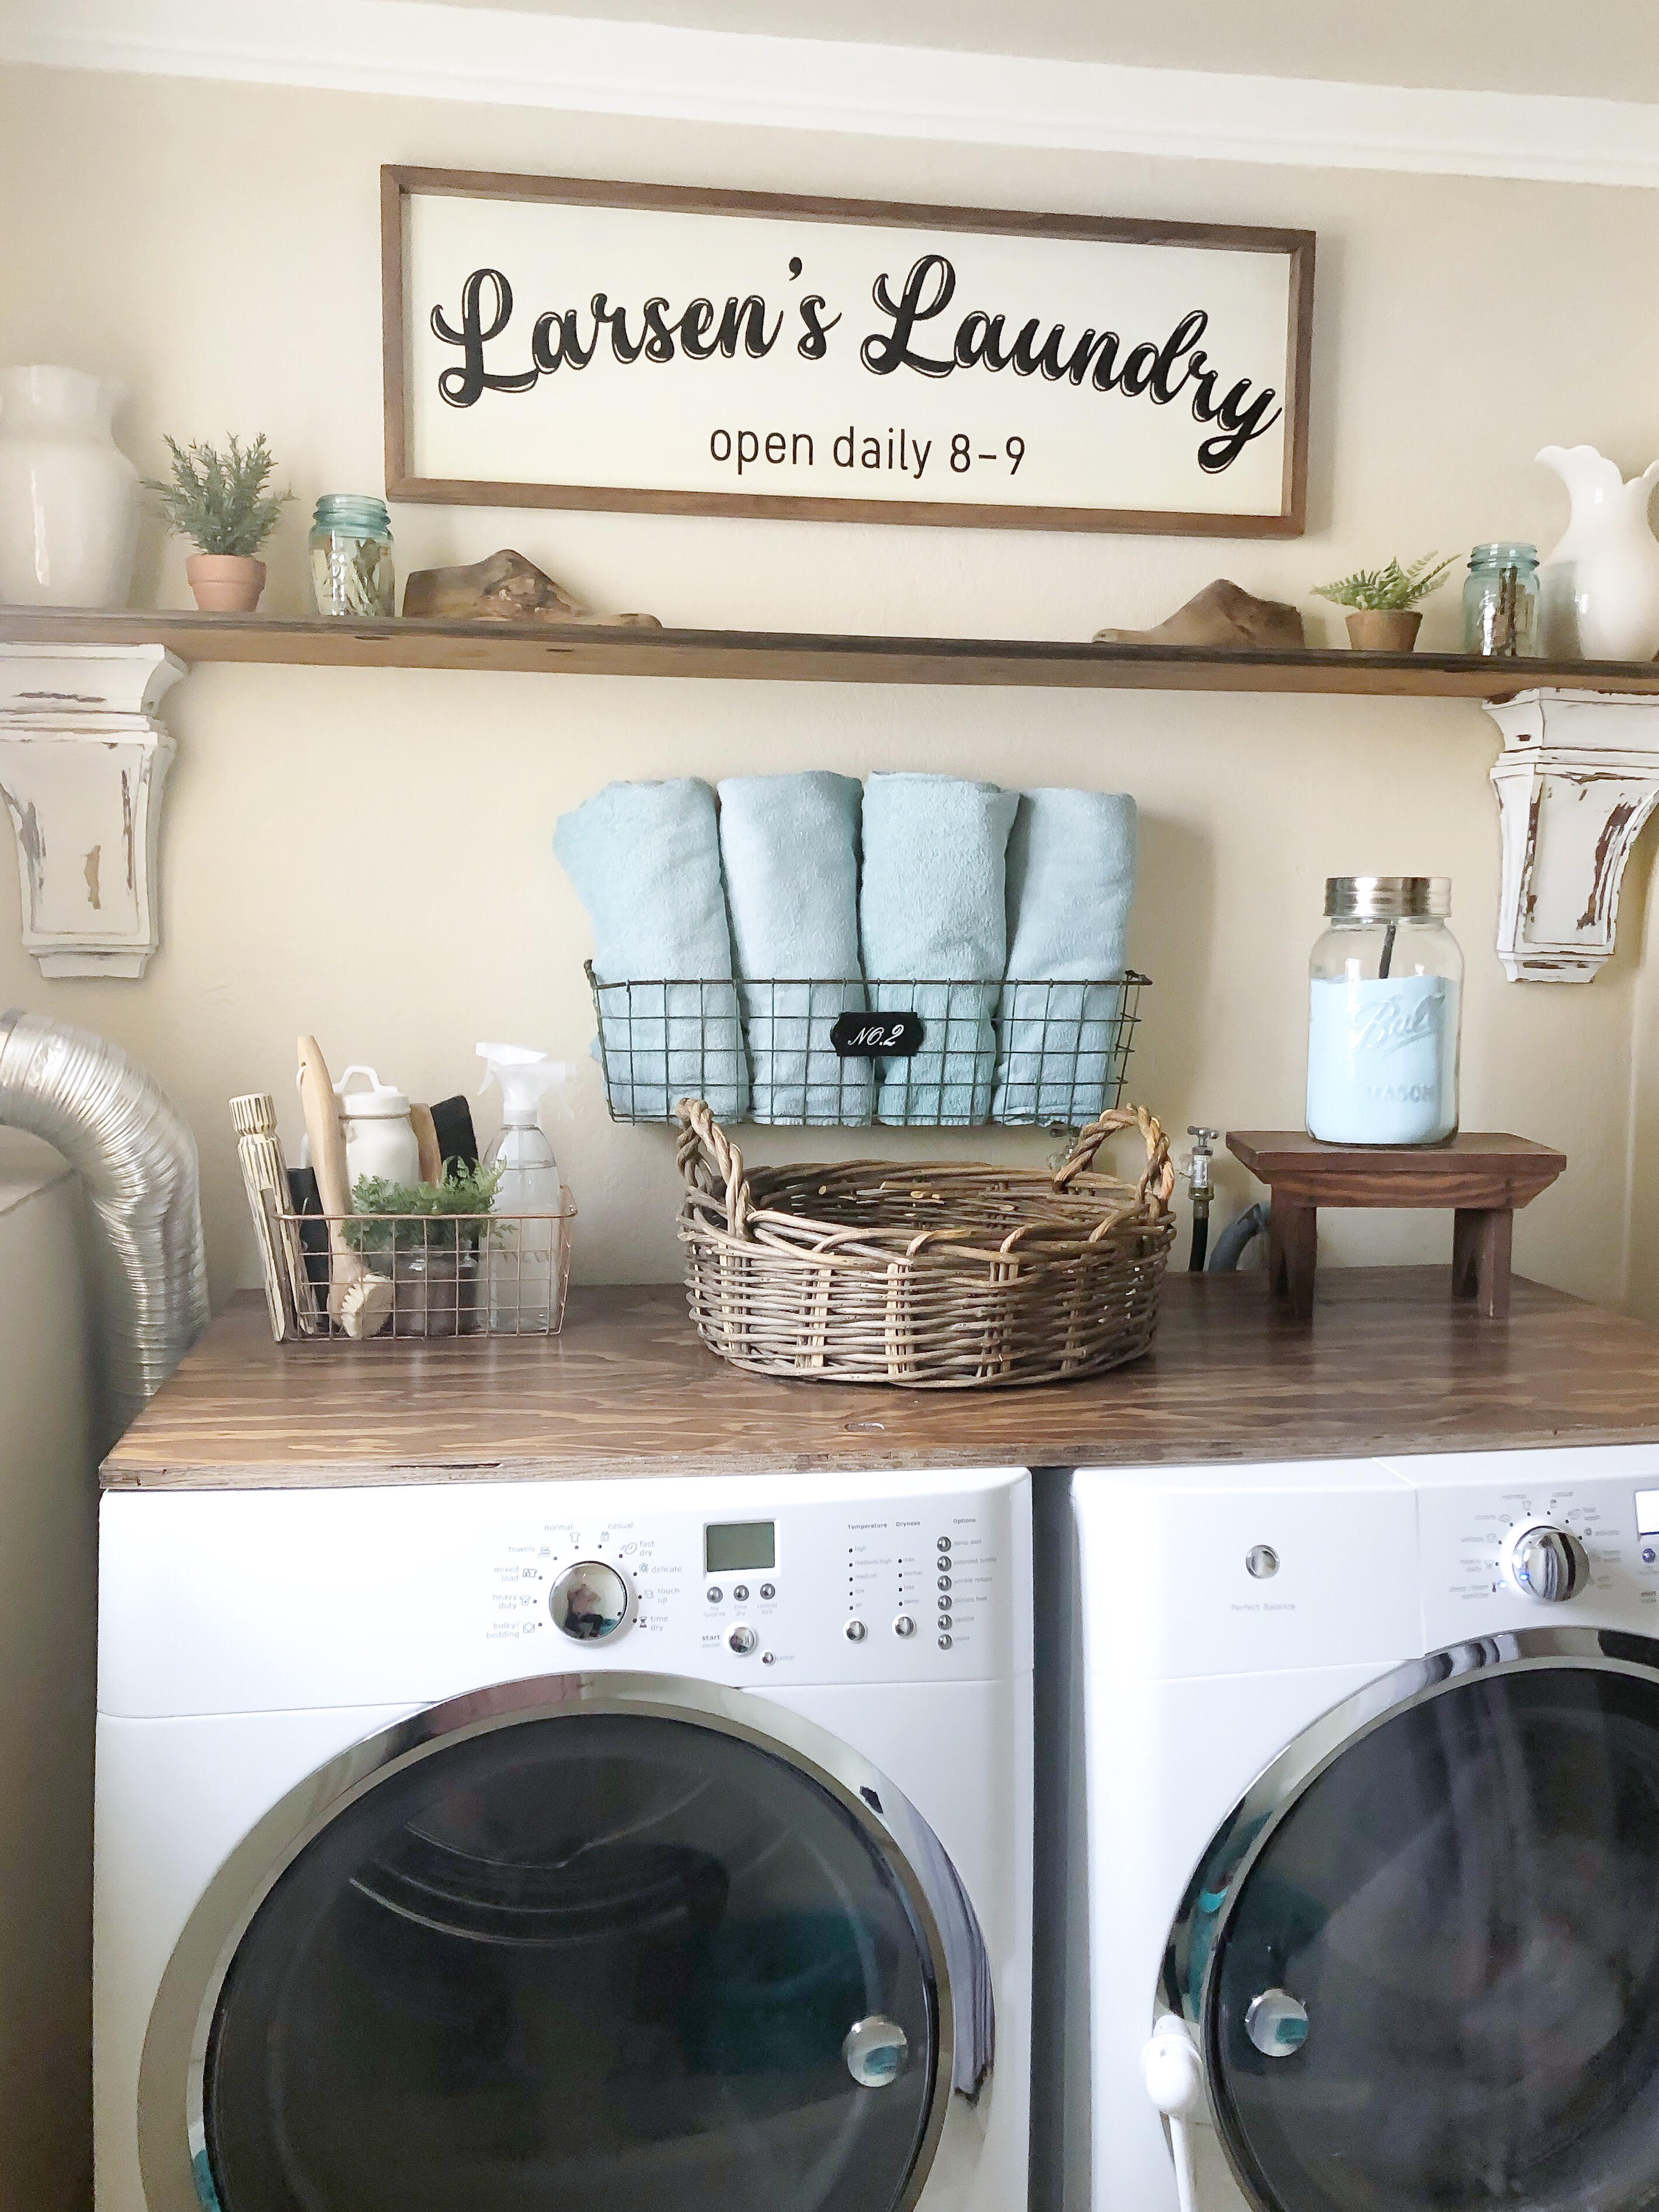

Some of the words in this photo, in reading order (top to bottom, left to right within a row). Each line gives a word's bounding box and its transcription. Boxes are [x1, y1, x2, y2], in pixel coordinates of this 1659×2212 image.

[430, 257, 841, 408] Larsen's
[860, 255, 1282, 474] Laundry
[711, 430, 813, 475] open
[834, 426, 931, 478] daily
[951, 434, 1024, 474] 8-9
[499, 1602, 517, 1610] duty
[651, 1624, 664, 1632] dry
[486, 1631, 520, 1640] bedding
